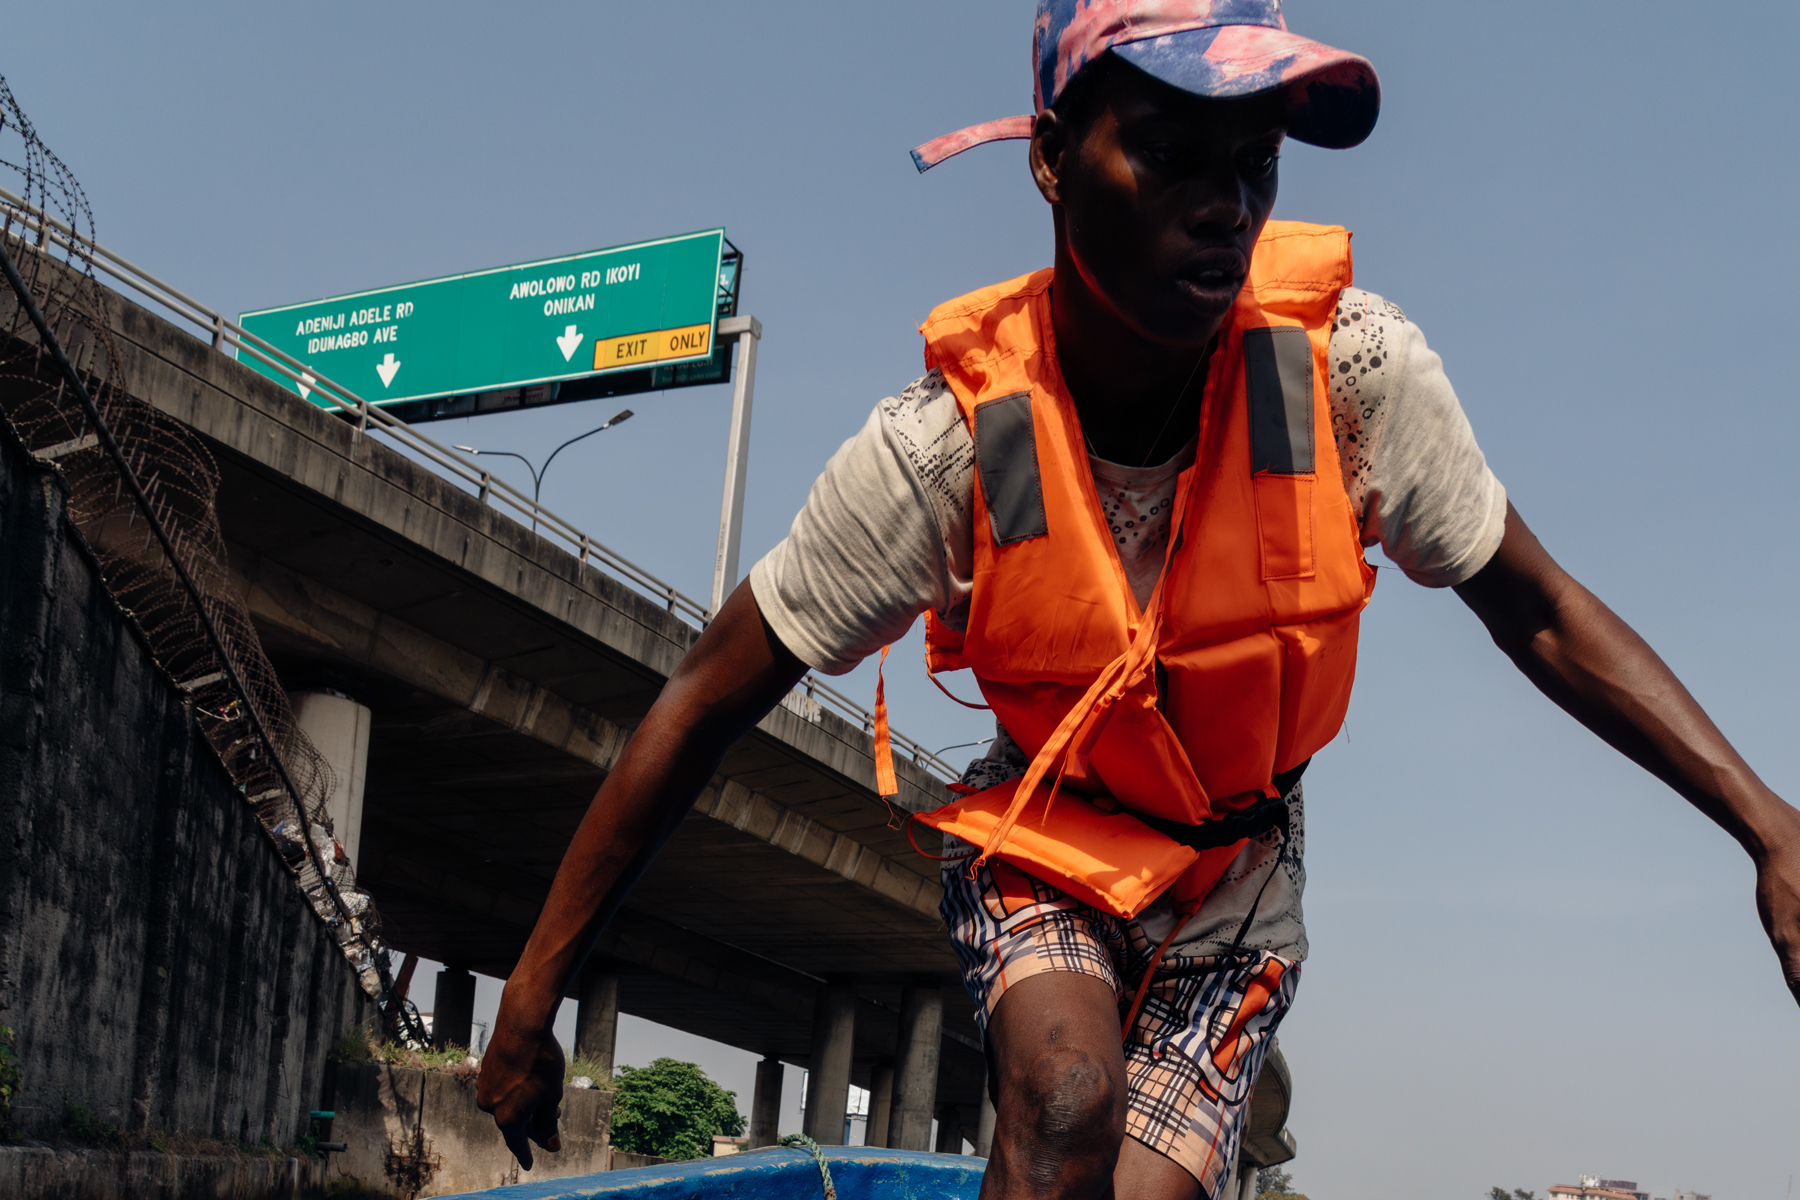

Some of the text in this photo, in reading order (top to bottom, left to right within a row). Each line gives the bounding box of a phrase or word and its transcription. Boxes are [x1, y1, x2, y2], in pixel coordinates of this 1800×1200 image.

[509, 262, 641, 300] AWOLOWO RD IKOYI
[295, 301, 414, 336] ADENIJI ADELE RD
[543, 293, 596, 317] ONIKAN
[307, 325, 399, 355] IDUMAGBO AVE
[616, 331, 706, 360] EXIT ONLY
